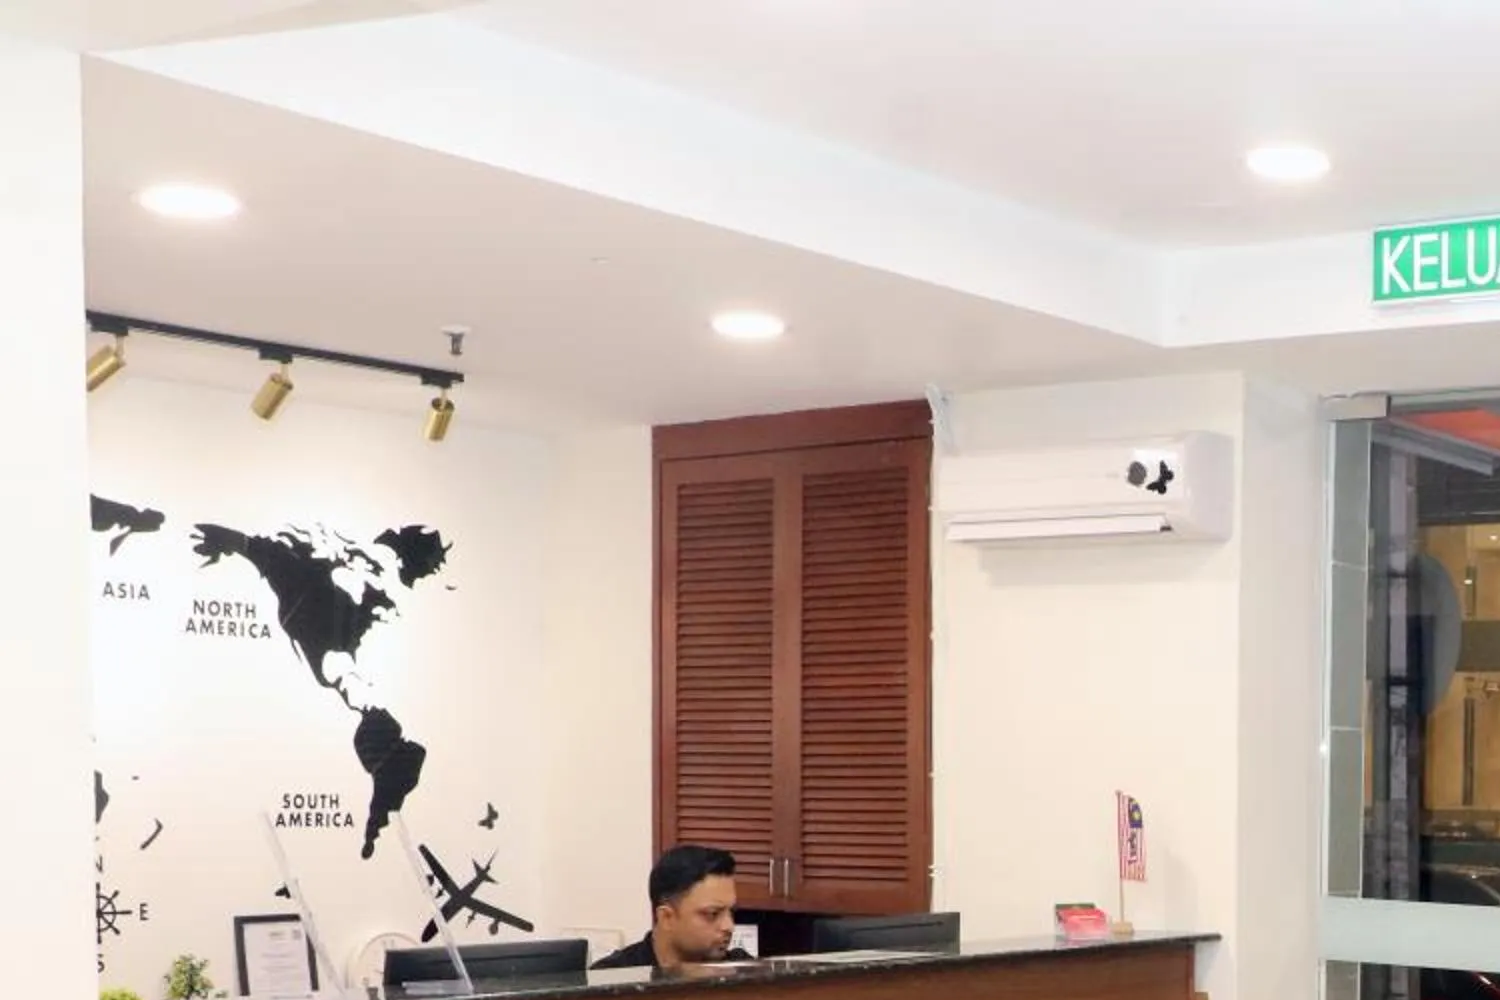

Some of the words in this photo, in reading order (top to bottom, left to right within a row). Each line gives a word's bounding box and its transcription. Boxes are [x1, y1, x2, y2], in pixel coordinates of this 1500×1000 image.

[102, 581, 151, 600] ASIA
[192, 600, 257, 618] NORTH
[185, 617, 272, 639] AMERICA
[282, 793, 340, 809] SOUTH
[275, 812, 355, 828] AMERICA
[139, 902, 149, 921] E
